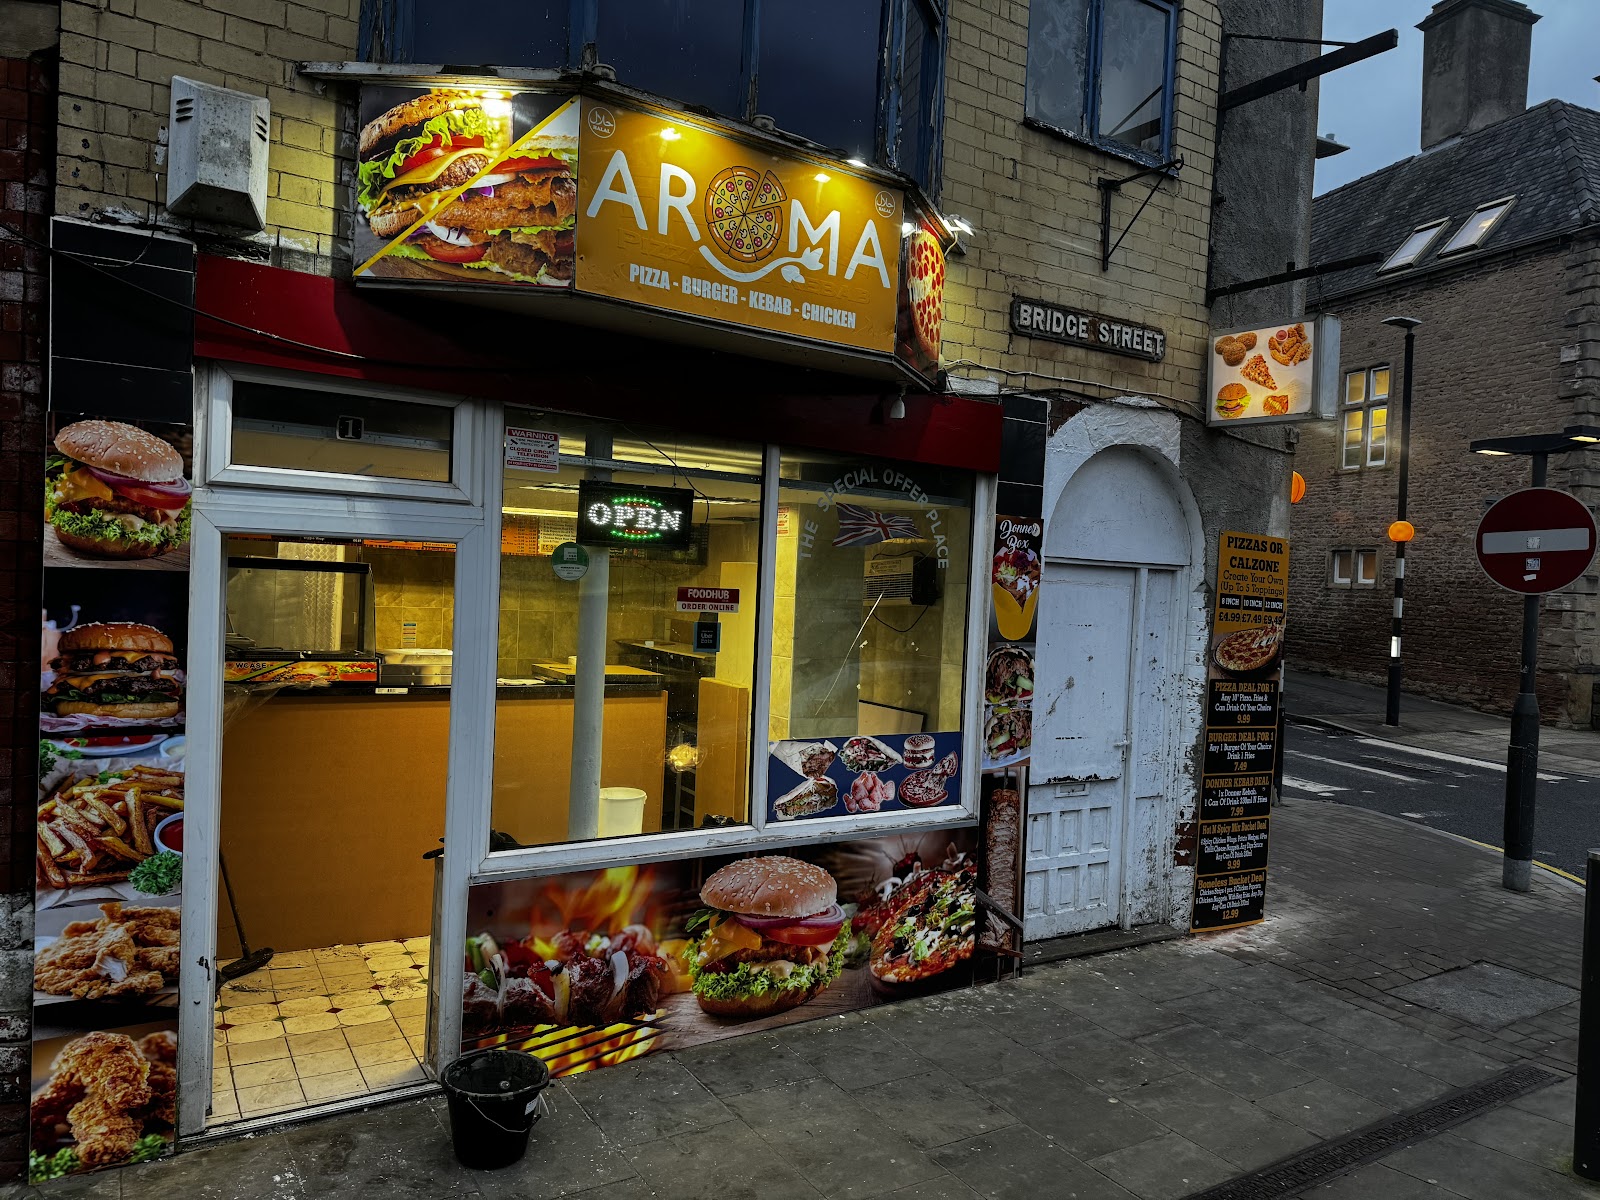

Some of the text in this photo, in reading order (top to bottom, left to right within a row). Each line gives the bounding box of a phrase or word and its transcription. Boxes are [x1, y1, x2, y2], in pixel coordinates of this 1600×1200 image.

[593, 125, 610, 134] HALAL
[587, 149, 890, 288] AROMA
[629, 264, 670, 290] PIZZA
[681, 278, 738, 305] BURGER
[749, 292, 791, 316] KEBAB
[802, 304, 856, 329] CHICKEN
[1019, 304, 1164, 356] BRIDGE STREET
[345, 419, 356, 438] 1
[511, 429, 555, 441] WARNING
[587, 502, 683, 531] OPEN
[799, 519, 818, 560] THE
[817, 468, 879, 513] SPECIAL
[882, 468, 929, 507] OFFER
[926, 509, 949, 569] PLACE
[1000, 520, 1039, 539] Donner
[1007, 535, 1029, 555] Box
[1227, 536, 1283, 554] PIZZAS OR
[1230, 556, 1279, 572] CALZONE
[1223, 570, 1284, 585] Create Your Own
[687, 588, 730, 599] FOODHUB
[1221, 581, 1284, 597] (Up To 5 Toppings)
[1219, 612, 1240, 621] £4.99
[1242, 614, 1261, 623] £7.49
[1215, 682, 1274, 692] PIZZA DEAL FOR 1
[1220, 694, 1231, 703] Any
[1215, 703, 1226, 712] Can
[1226, 704, 1240, 712] Drink
[1256, 704, 1272, 712] Choice
[1237, 714, 1251, 724] 9.99
[1208, 732, 1273, 742] BURGER DEAL FOR 1
[1209, 744, 1220, 753] Any
[1224, 743, 1240, 752] Burger
[1226, 752, 1240, 760] Drink
[1234, 762, 1247, 771] 7.49
[1205, 776, 1269, 789] DONNER KEBAB DEAL
[1226, 797, 1240, 805] Drink
[1230, 807, 1244, 816] 7.99
[1202, 825, 1211, 834] Hot
[1217, 824, 1231, 835] Spicy
[1241, 822, 1256, 831] Bucket
[1257, 820, 1267, 830] Deal
[1227, 860, 1241, 869] 9.99
[1228, 874, 1250, 885] Bucket
[1251, 872, 1264, 882] Deal
[1222, 909, 1239, 919] 12.99
